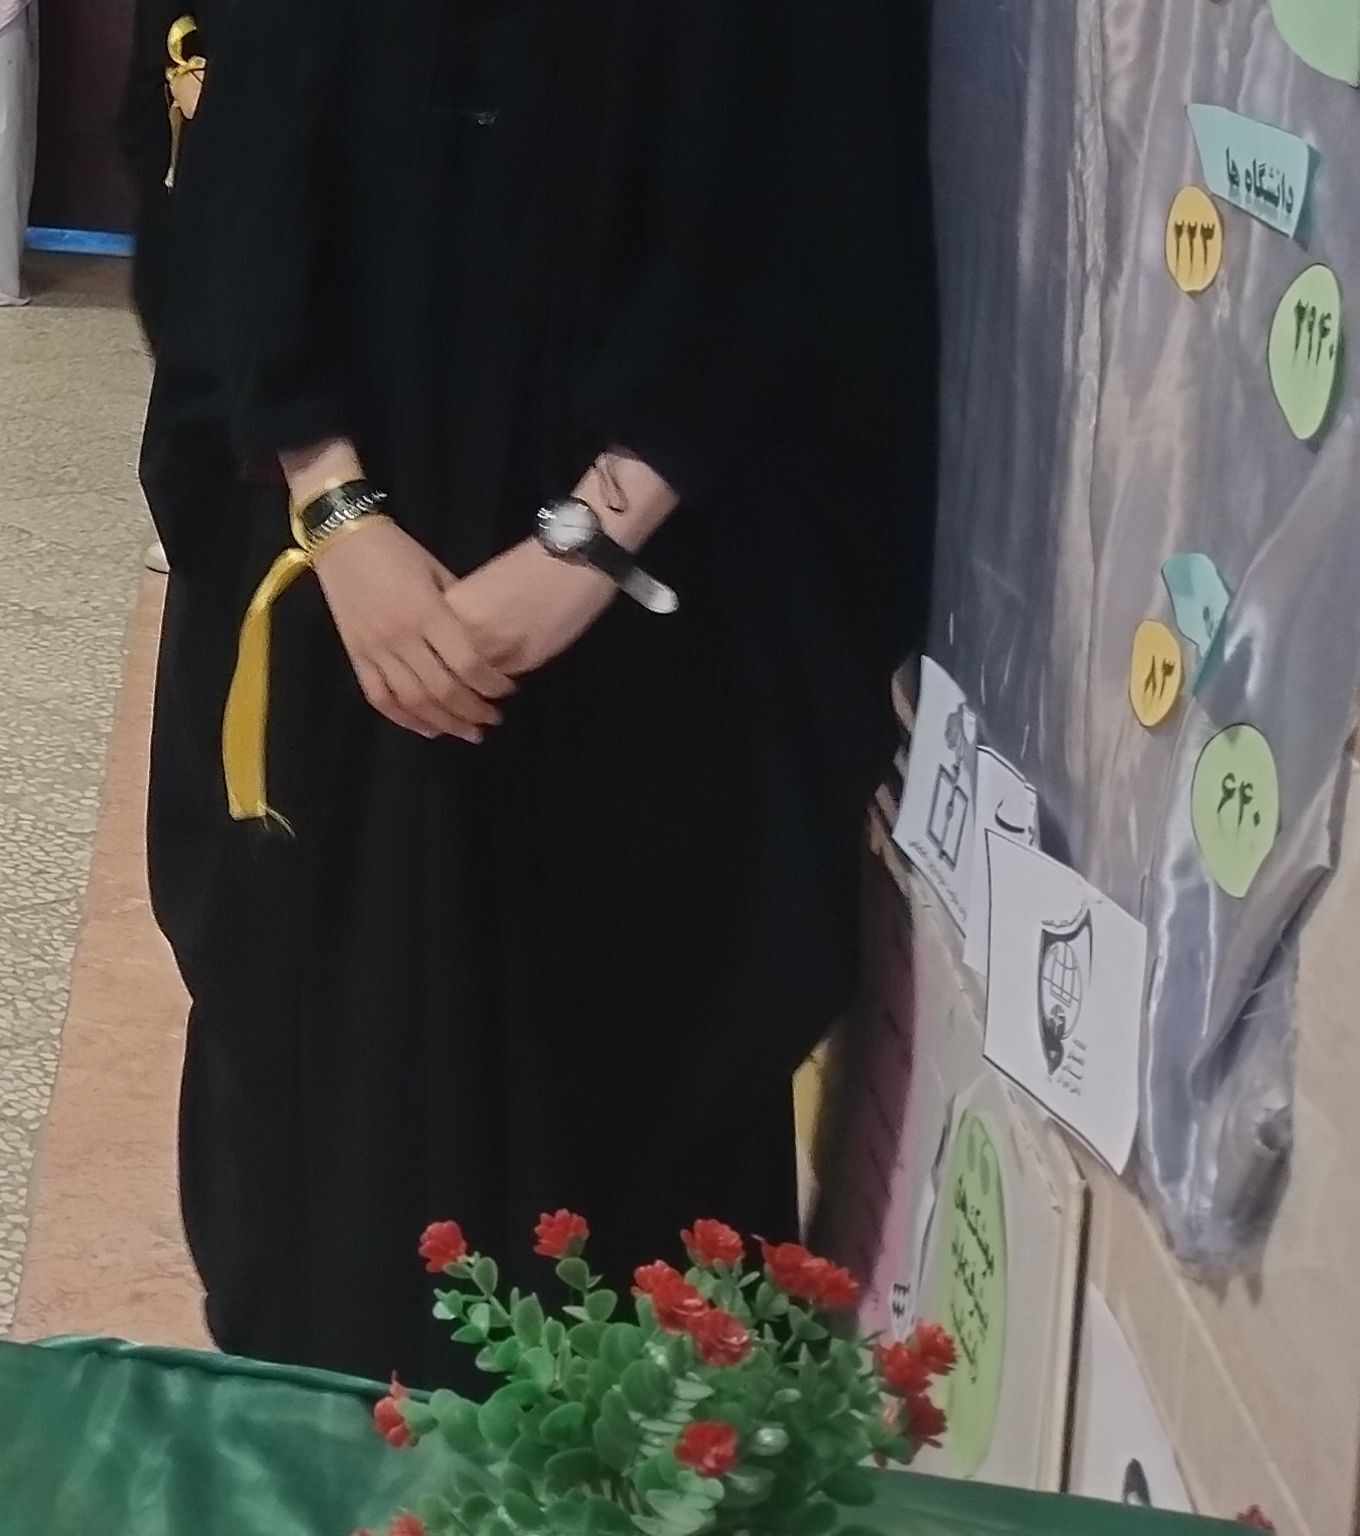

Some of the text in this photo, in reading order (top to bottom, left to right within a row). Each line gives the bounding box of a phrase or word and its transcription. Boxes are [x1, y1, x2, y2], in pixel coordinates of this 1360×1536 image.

[1225, 146, 1295, 215] دانشگاه ها
[1173, 219, 1216, 267] ۲۲۳
